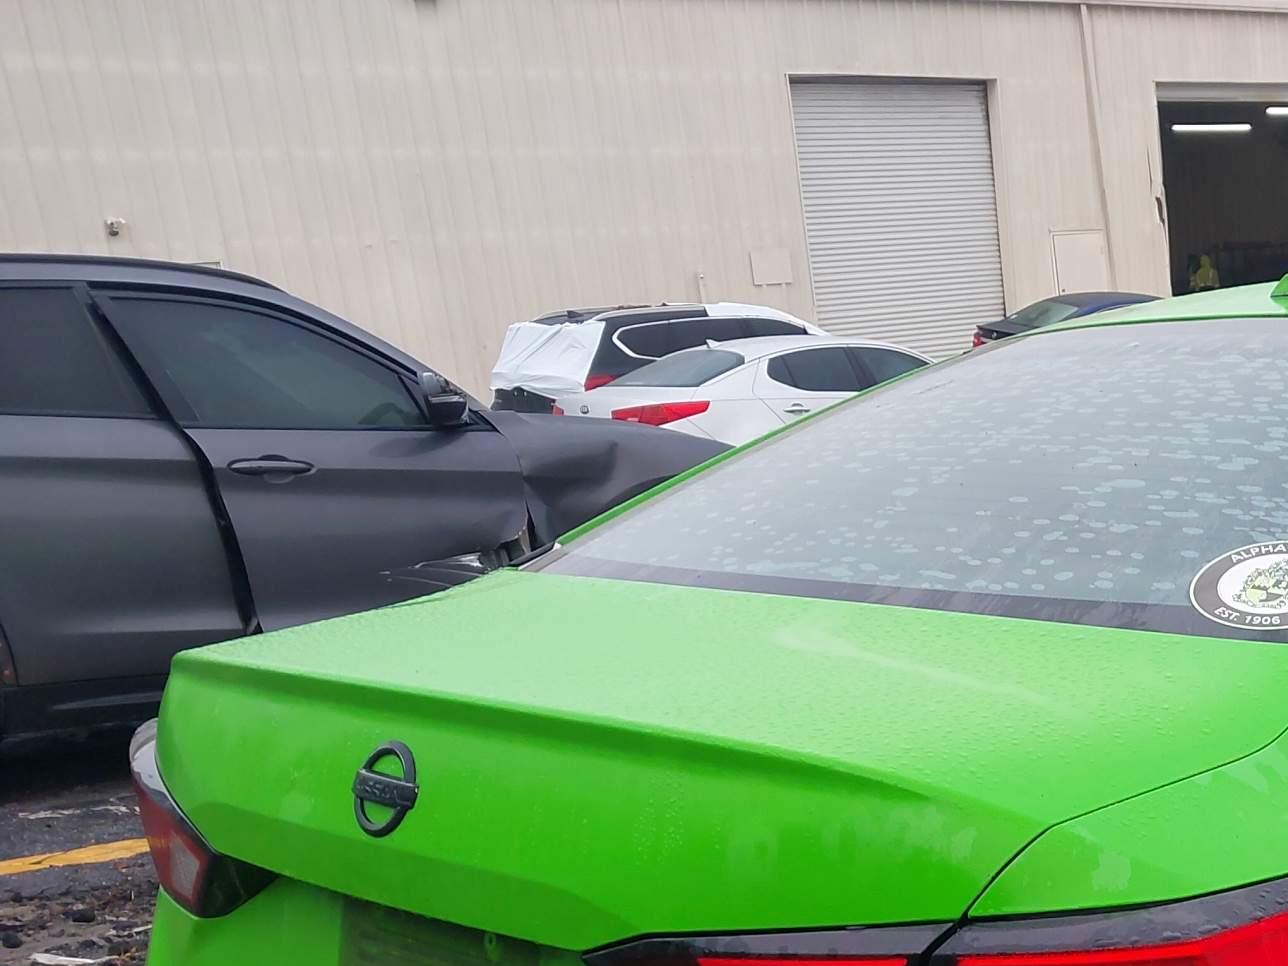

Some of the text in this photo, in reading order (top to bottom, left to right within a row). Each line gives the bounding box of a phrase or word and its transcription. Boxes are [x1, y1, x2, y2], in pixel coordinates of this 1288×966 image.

[1230, 543, 1288, 564] ALPHA
[1213, 606, 1281, 626] EST. 1906
